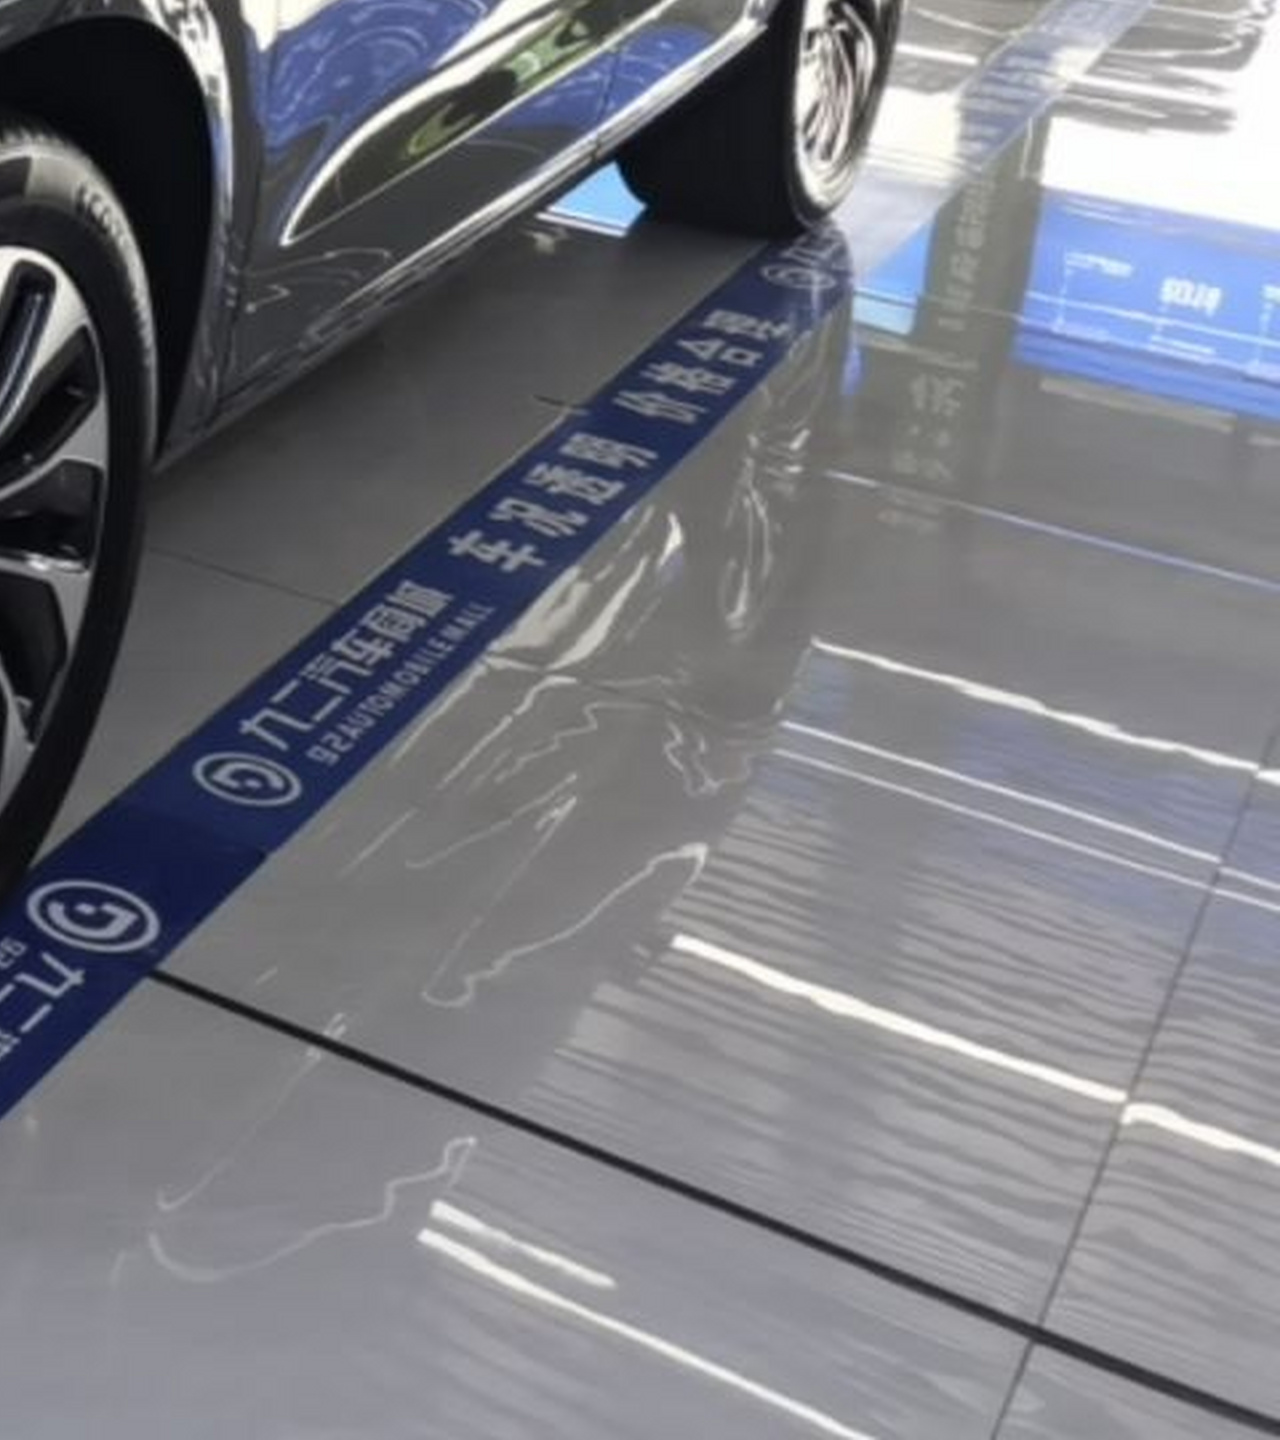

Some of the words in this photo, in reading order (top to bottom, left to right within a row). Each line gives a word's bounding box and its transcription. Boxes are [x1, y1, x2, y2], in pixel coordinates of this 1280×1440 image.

[447, 431, 658, 572] 车况透明
[612, 309, 792, 425] 价格合理
[239, 579, 454, 752] 九二汽车商城
